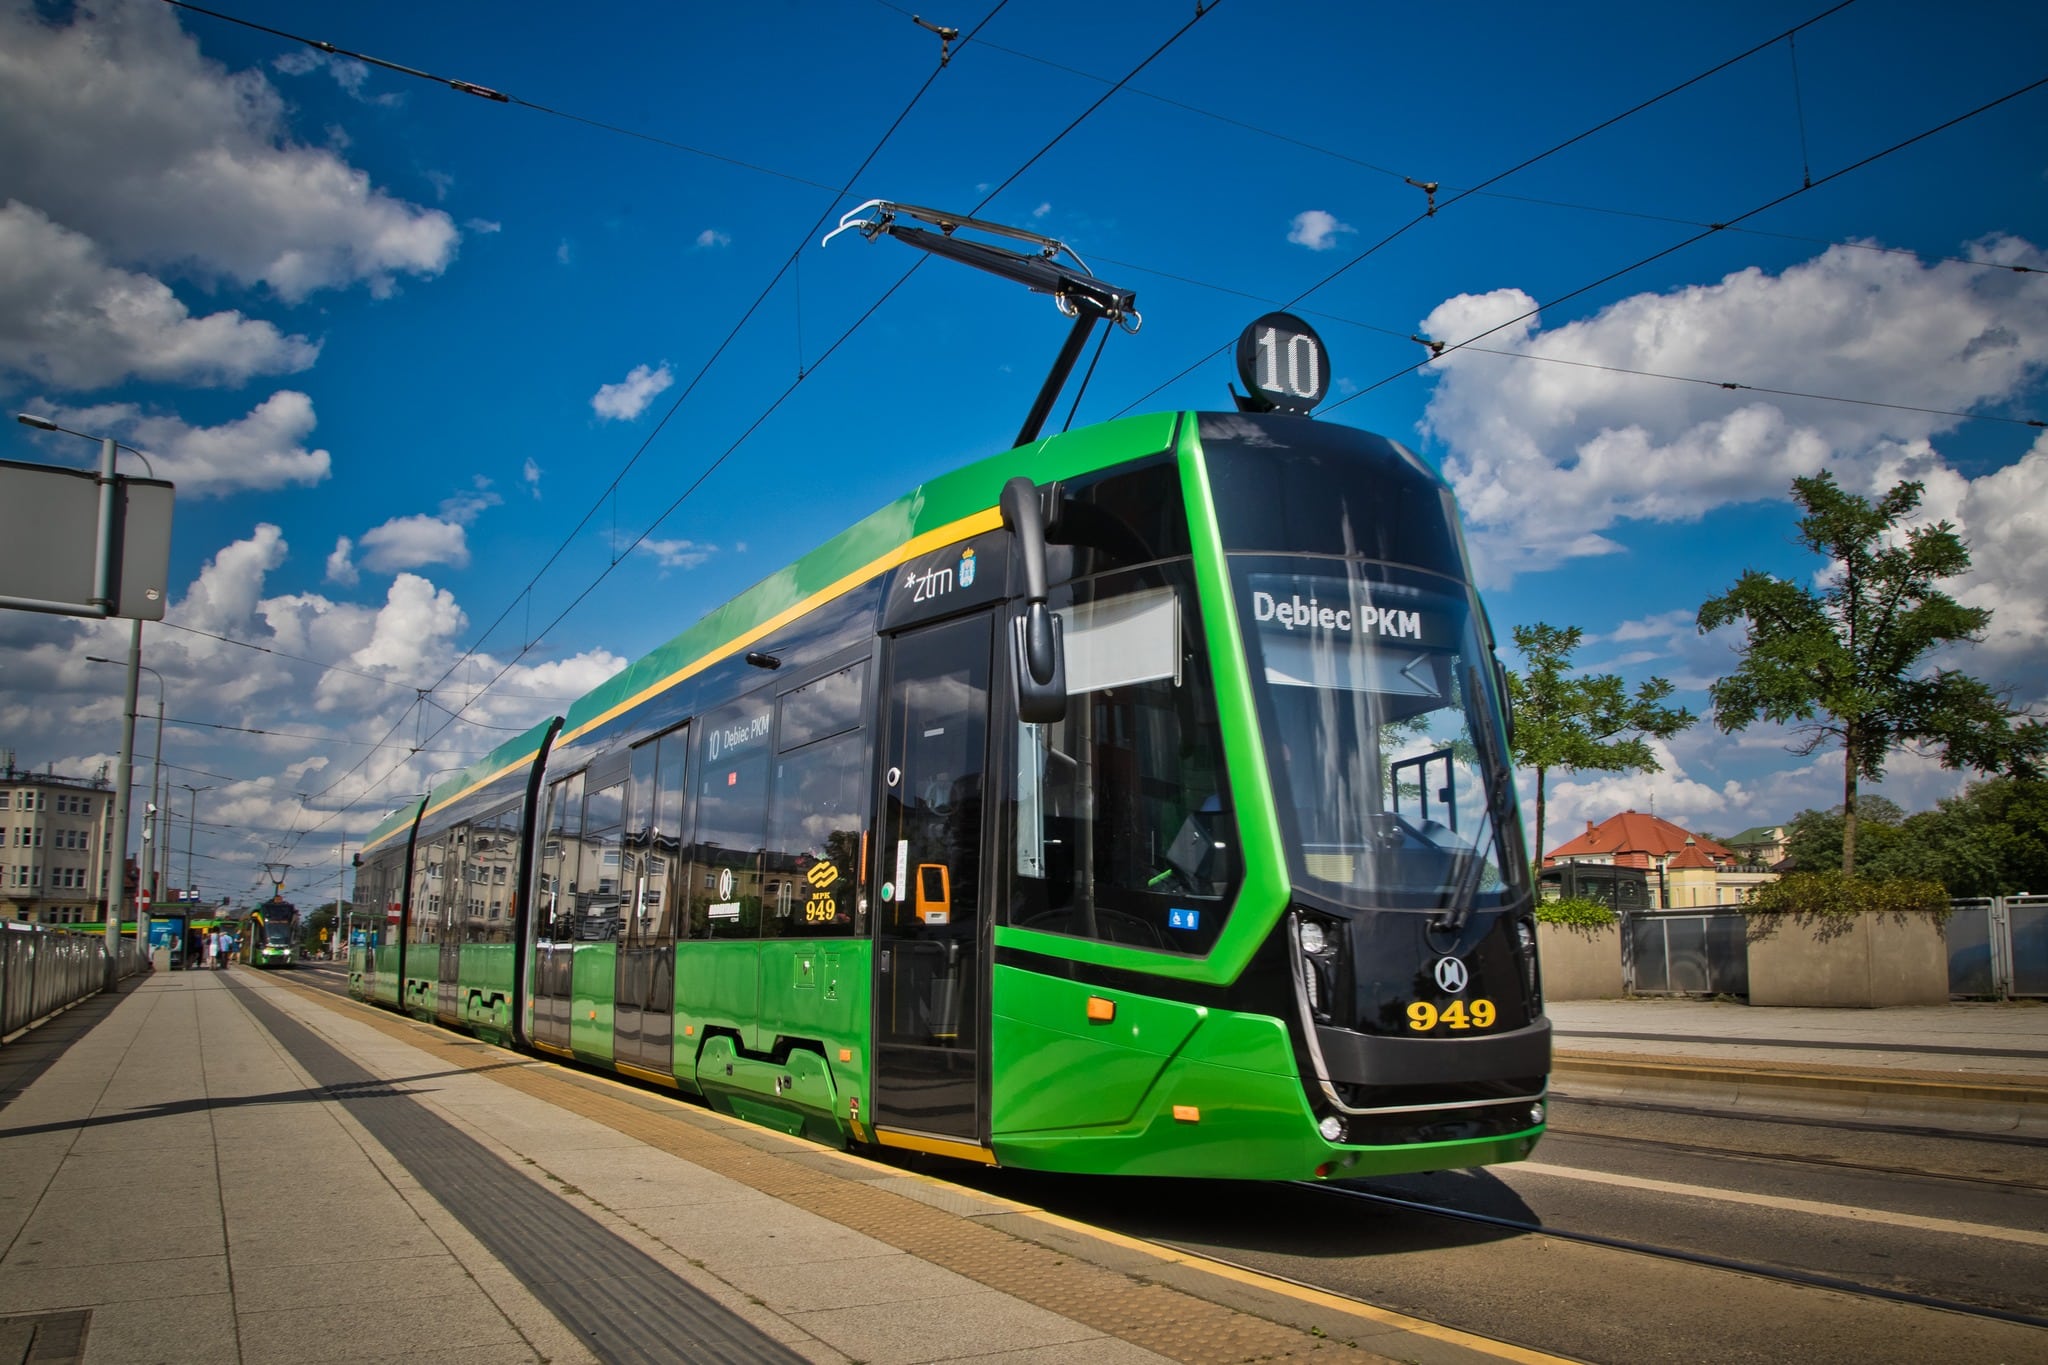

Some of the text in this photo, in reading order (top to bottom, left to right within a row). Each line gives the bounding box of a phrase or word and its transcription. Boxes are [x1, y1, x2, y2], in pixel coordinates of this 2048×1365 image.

[1258, 327, 1320, 399] 10
[1253, 591, 1422, 640] Dębiec PKM
[708, 713, 770, 762] 10 Dębiec PKM
[806, 898, 836, 922] 949
[812, 892, 831, 900] MPK
[1406, 998, 1497, 1031] 949
